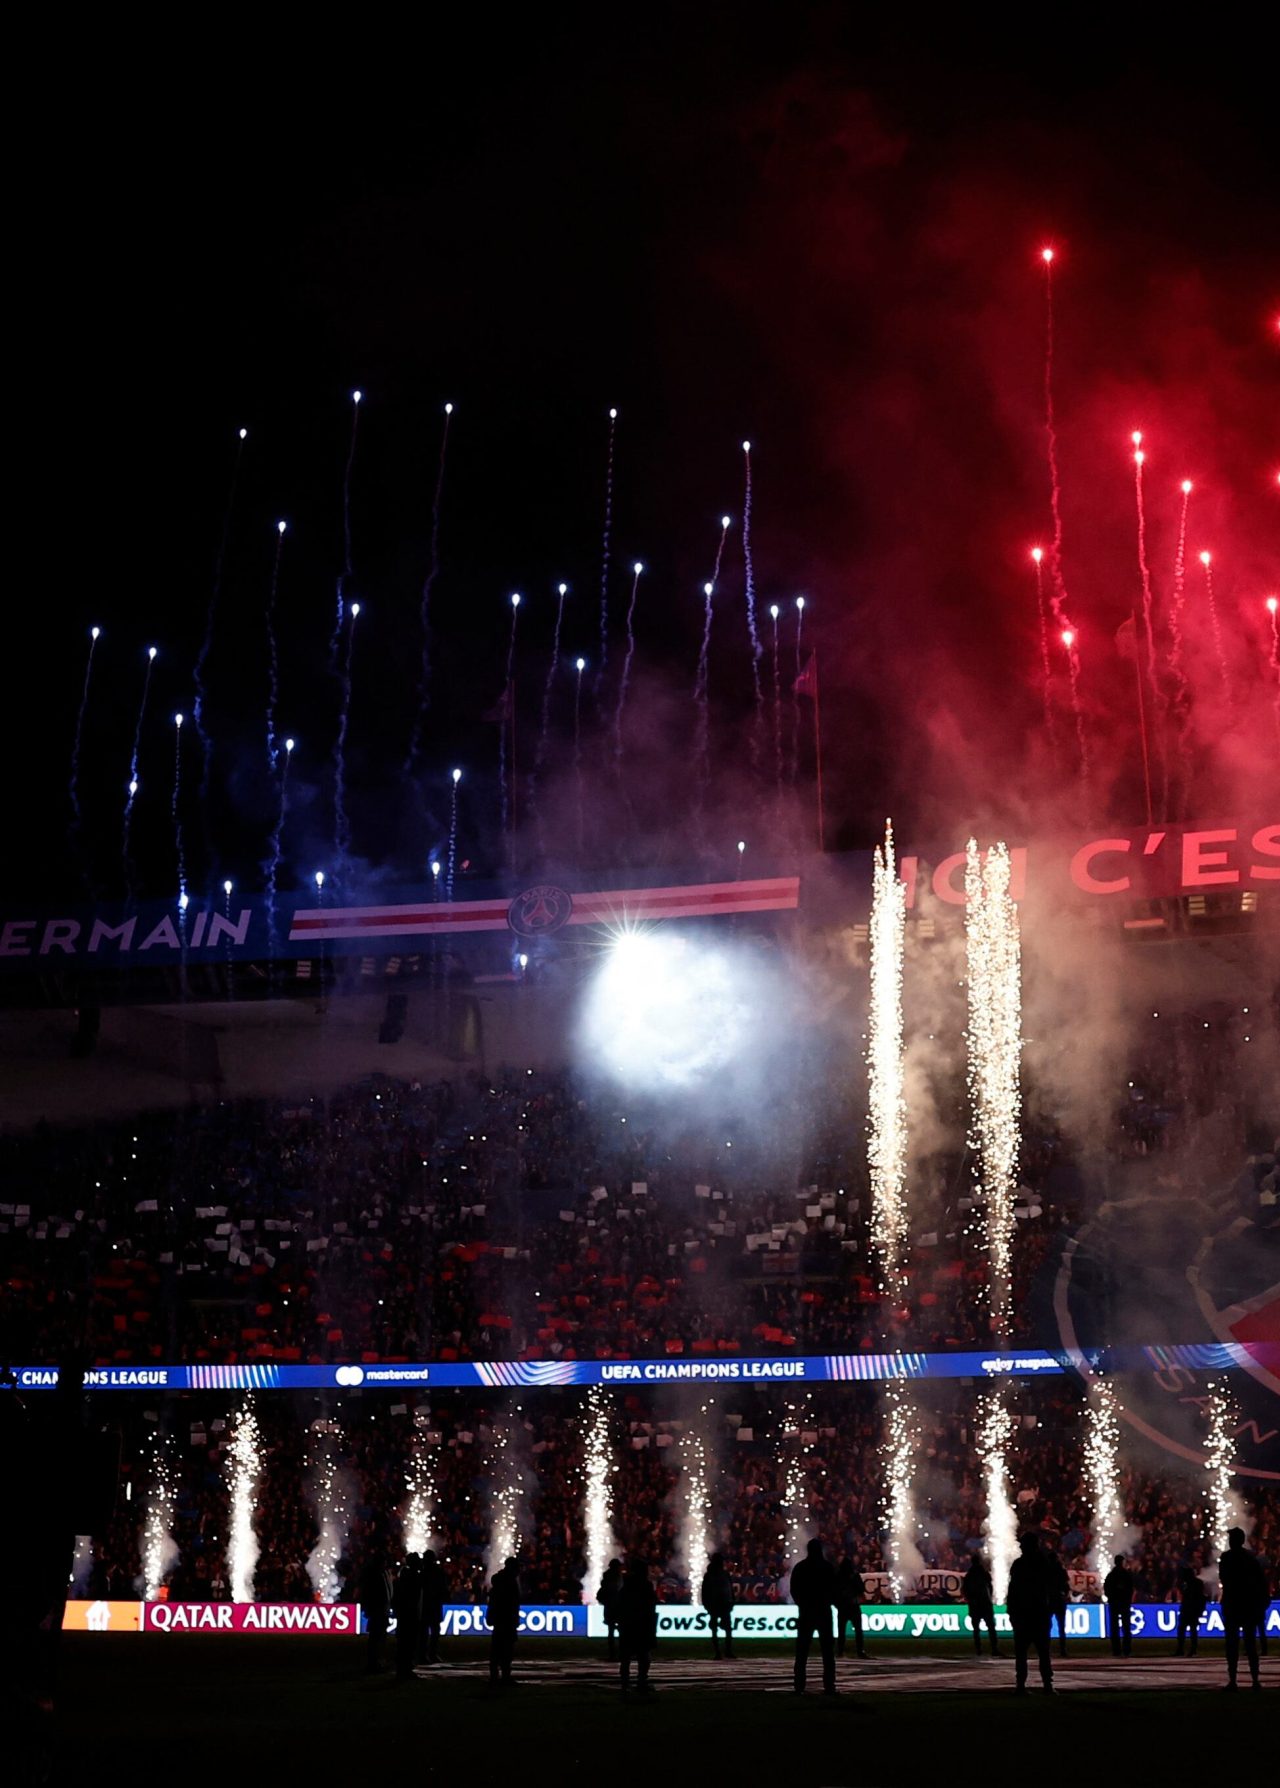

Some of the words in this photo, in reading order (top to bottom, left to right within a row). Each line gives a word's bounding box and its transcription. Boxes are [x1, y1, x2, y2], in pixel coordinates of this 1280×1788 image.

[110, 1370, 168, 1385] LEAGUE
[366, 1368, 429, 1380] mastercard
[601, 1365, 641, 1380] UEFA
[644, 1363, 740, 1379] CHAMPIONS
[742, 1362, 805, 1377] LEAGUE
[151, 1603, 233, 1630] QATAR
[243, 1602, 350, 1631] AIRWAYS
[910, 1612, 960, 1637] you
